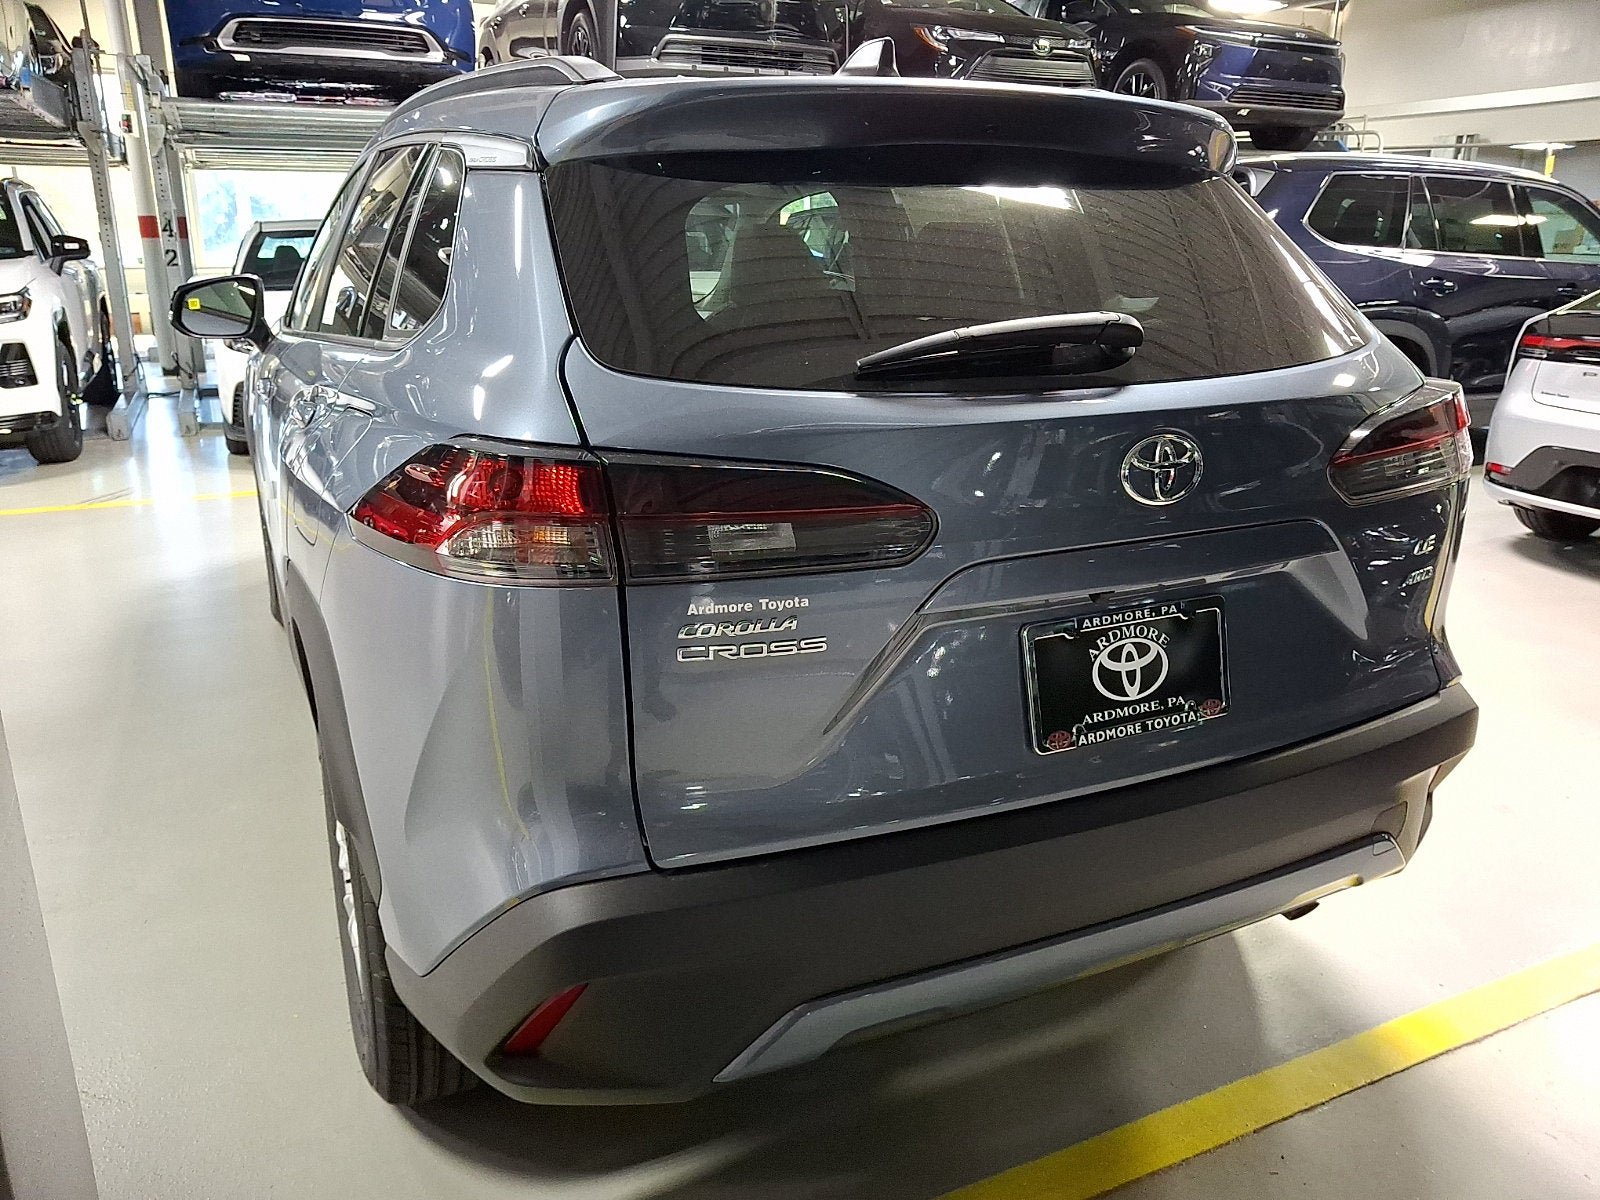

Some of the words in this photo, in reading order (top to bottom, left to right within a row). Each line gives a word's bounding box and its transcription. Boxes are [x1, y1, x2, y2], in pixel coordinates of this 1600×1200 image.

[165, 249, 179, 266] 2
[1413, 533, 1437, 556] LE
[687, 600, 753, 616] Ardmore
[759, 596, 810, 612] Toyota
[1082, 608, 1156, 629] ARDMORE,
[1161, 605, 1178, 615] PA
[677, 615, 799, 640] COROLLA
[676, 636, 828, 663] CROSS
[1088, 625, 1171, 662] ARDMORE
[1082, 700, 1165, 726] ARDMORE,
[1167, 695, 1186, 708] PA
[1077, 722, 1143, 747] ARDMORE
[1145, 710, 1197, 731] TOYOTA
